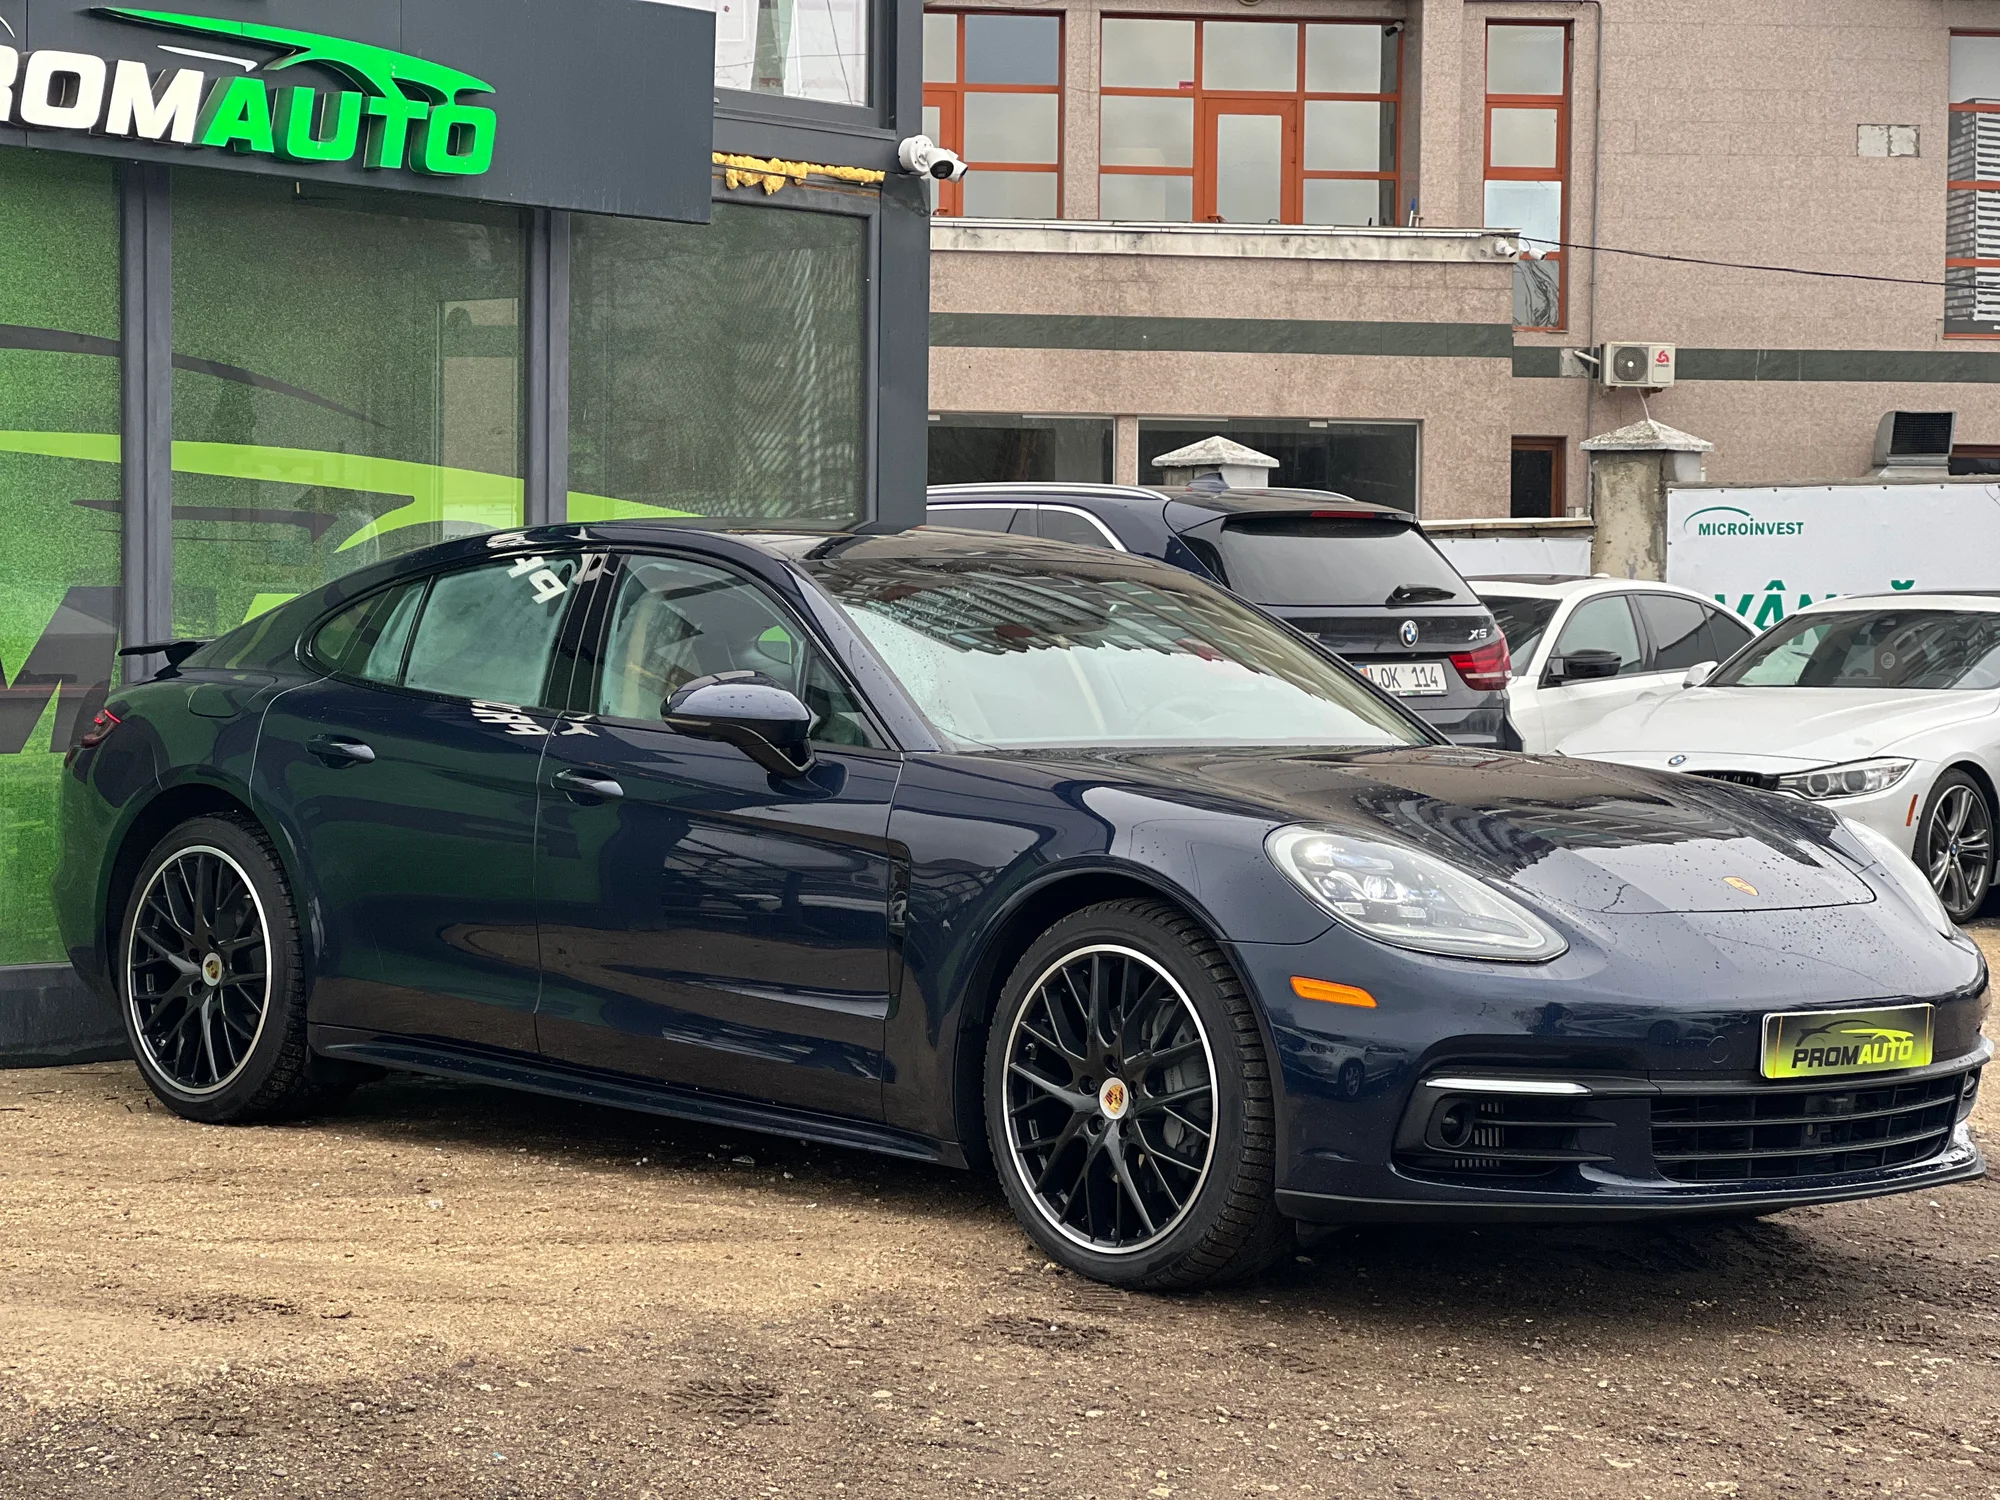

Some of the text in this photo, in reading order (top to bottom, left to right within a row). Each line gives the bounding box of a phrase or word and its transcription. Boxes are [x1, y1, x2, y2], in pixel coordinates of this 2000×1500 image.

[0, 45, 497, 175] OMAUTO
[1468, 628, 1488, 641] X5
[1411, 666, 1439, 688] 114
[1791, 1040, 1914, 1068] PROMAUTO
